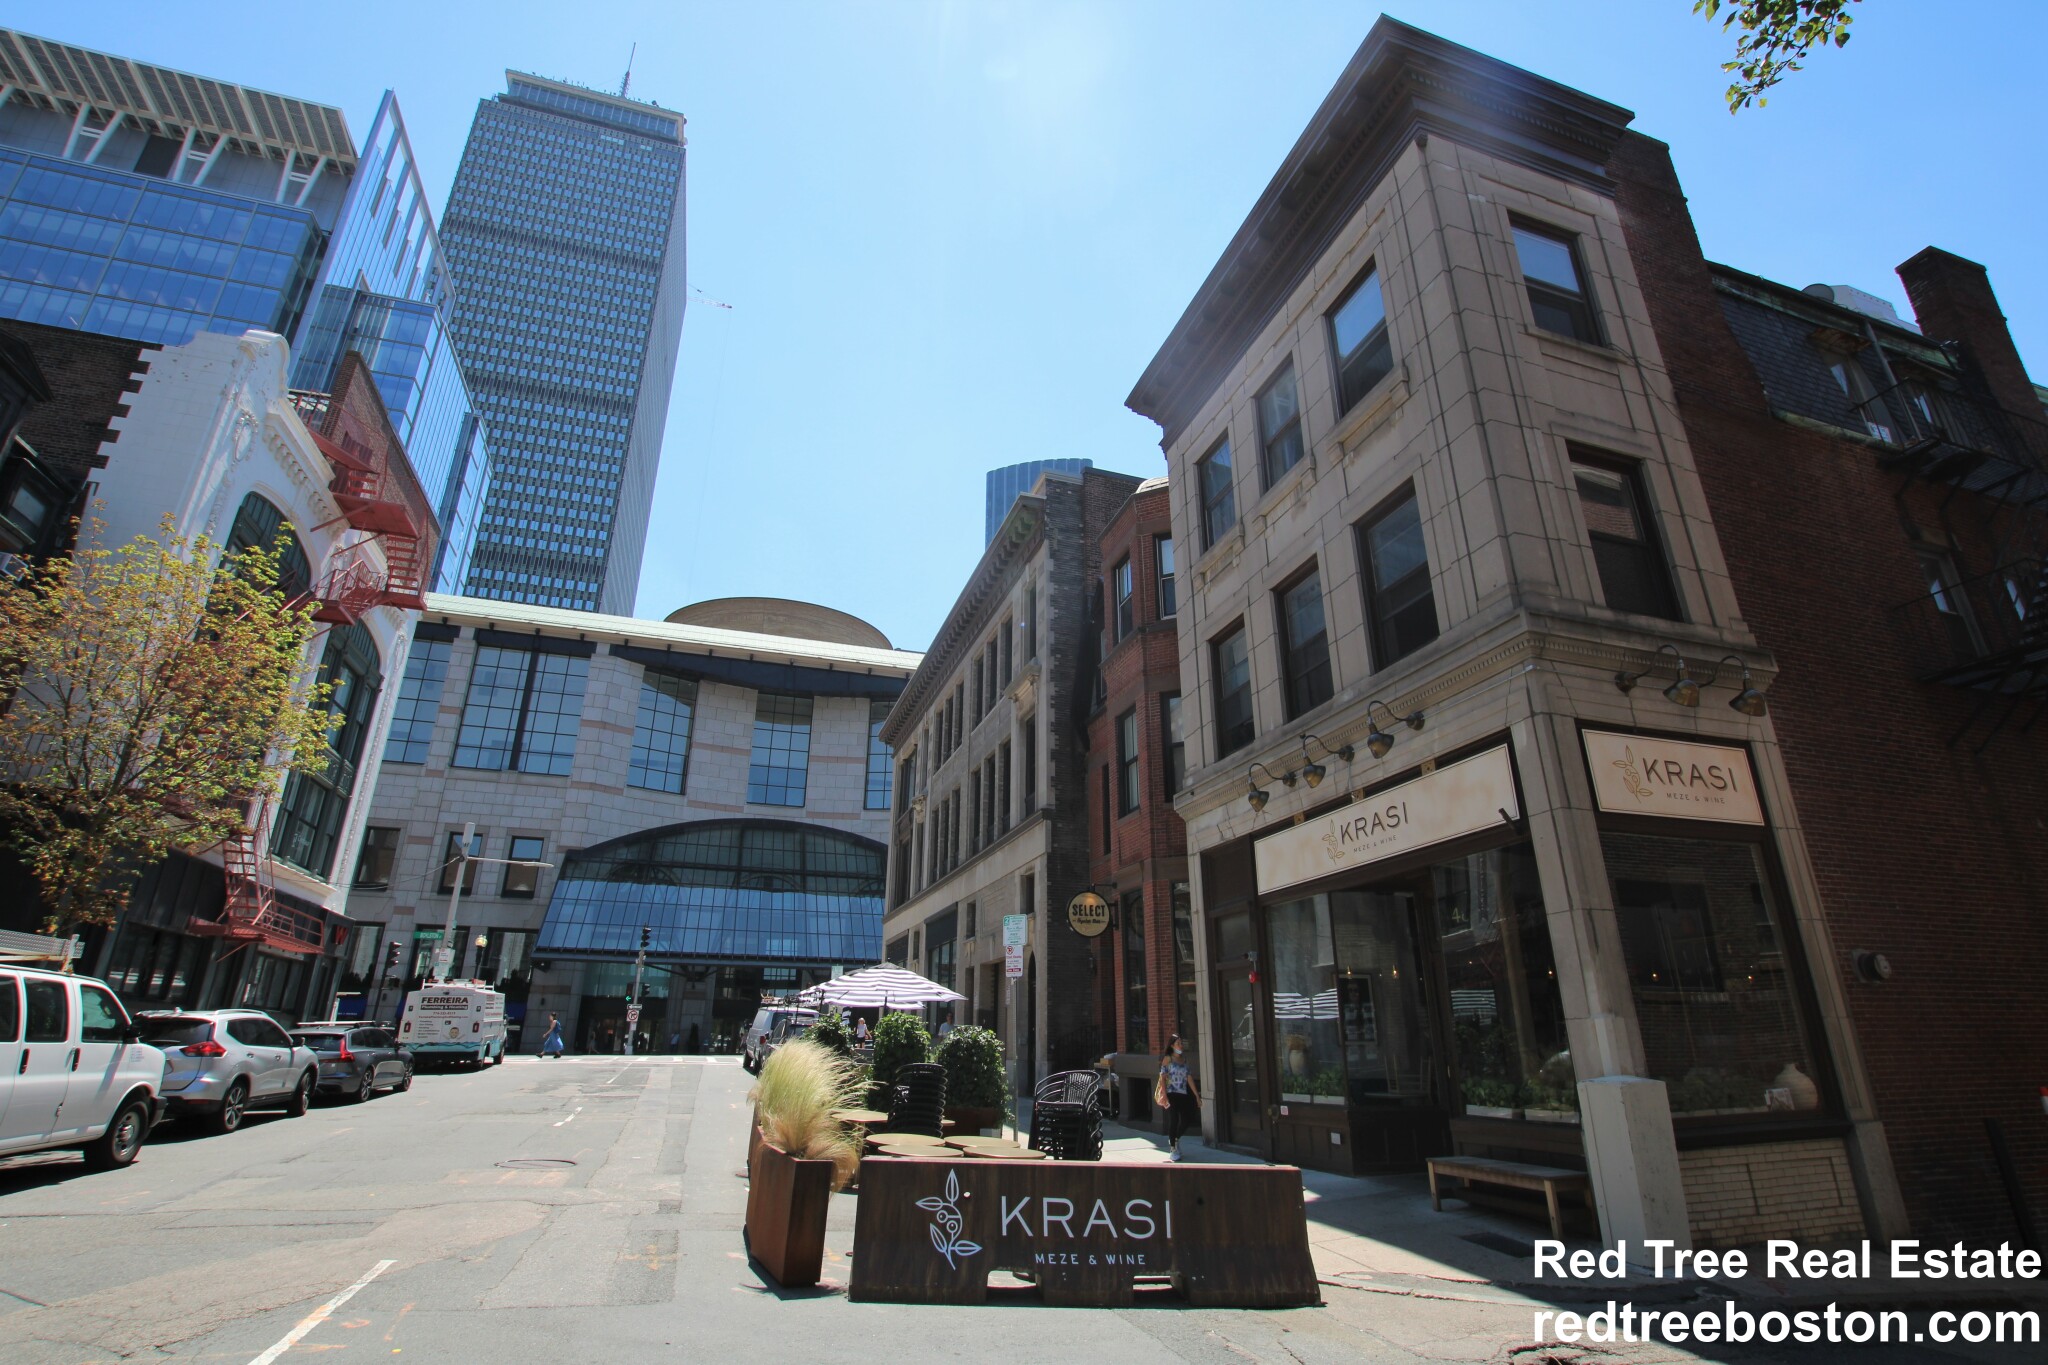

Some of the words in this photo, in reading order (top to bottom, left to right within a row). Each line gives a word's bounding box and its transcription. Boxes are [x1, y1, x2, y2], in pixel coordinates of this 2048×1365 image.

[1642, 757, 1738, 793] KRASI
[1666, 793, 1690, 801] MEZE
[1340, 801, 1409, 845] KRASI
[1353, 844, 1370, 853] MEZE
[1380, 835, 1397, 845] WINE
[1072, 903, 1106, 917] SELECT
[421, 996, 469, 1004] FERREIRA
[1001, 1195, 1172, 1239] KRASI
[1035, 1253, 1079, 1265] MEZE
[1088, 1254, 1097, 1265] &
[1105, 1254, 1146, 1265] WINE
